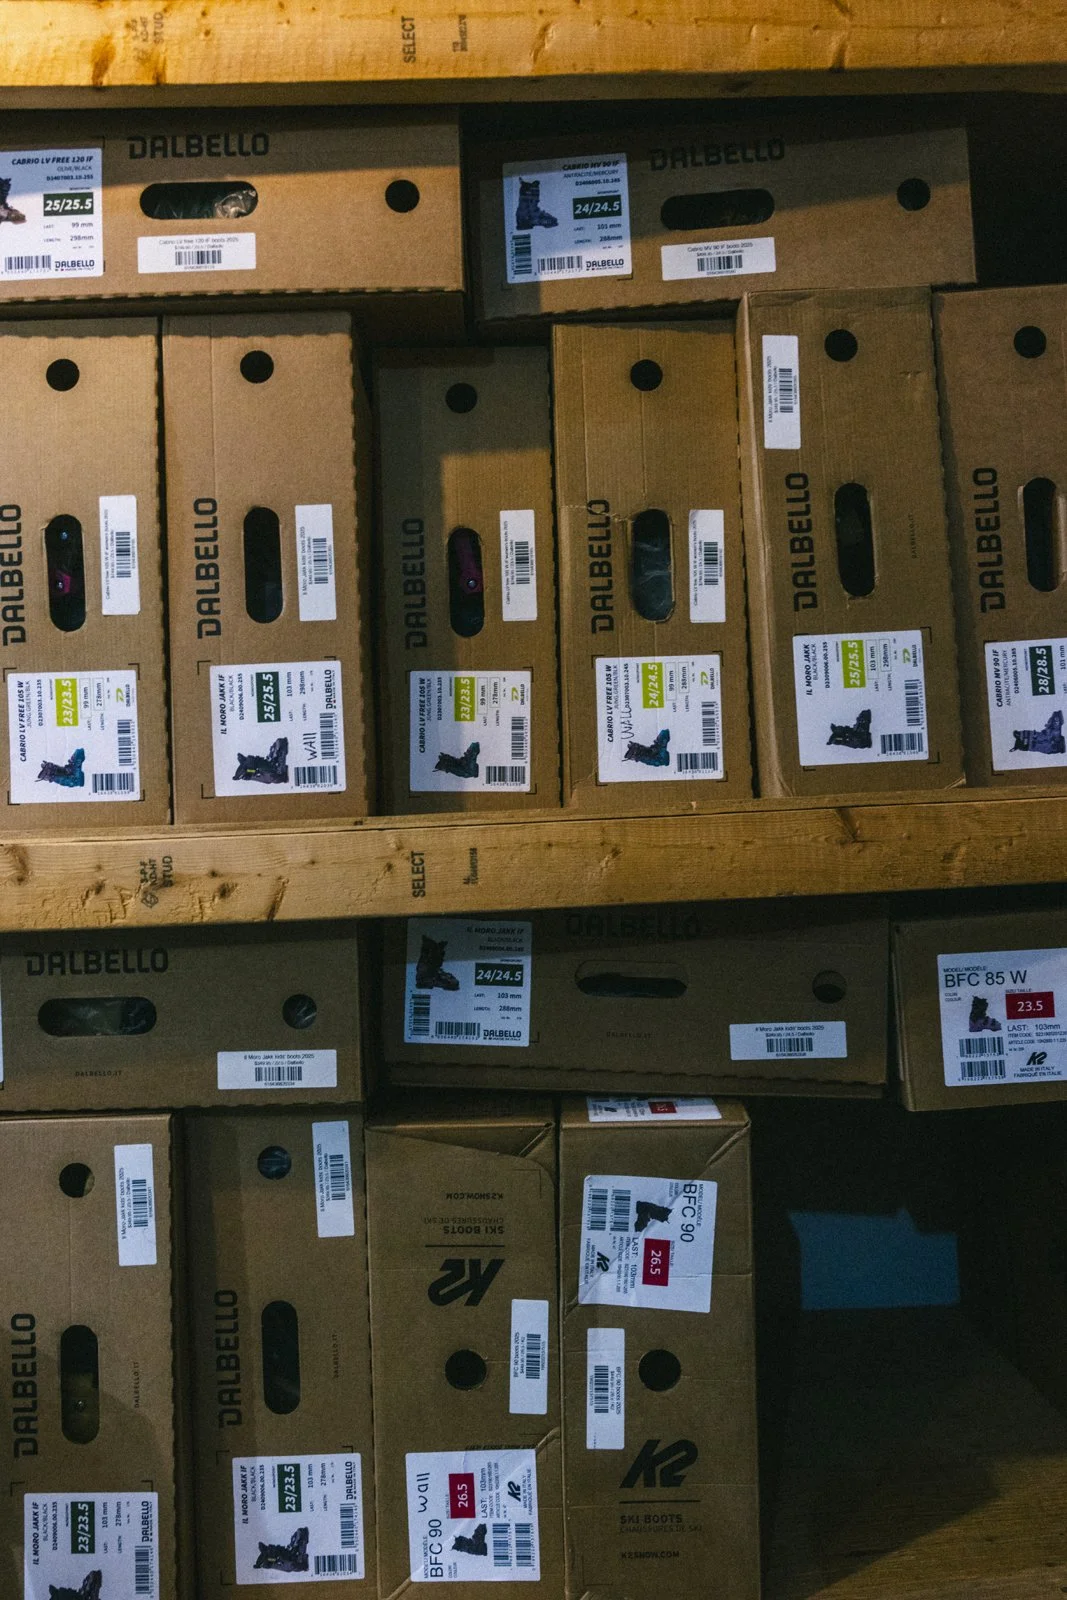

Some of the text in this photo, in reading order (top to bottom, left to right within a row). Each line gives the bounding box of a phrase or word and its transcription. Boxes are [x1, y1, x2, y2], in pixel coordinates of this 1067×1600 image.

[401, 16, 416, 63] SELECT
[127, 132, 270, 159] DALBELLO
[650, 138, 785, 171] DALBELLO
[12, 158, 40, 166] CABRIO
[44, 199, 93, 212] 25/25.5
[574, 201, 620, 215] 24/24.5
[55, 260, 95, 269] DALBELLO
[585, 258, 624, 269] DALBELLO
[785, 473, 818, 613] DALBELLO
[973, 467, 1005, 613] DALBELLO
[0, 504, 25, 646] DALBELLO
[194, 498, 221, 640] DALBELLO
[587, 499, 614, 634] DALBELLO
[402, 518, 428, 651] DALBELLO
[803, 644, 811, 663] JAKK
[847, 641, 861, 686] 25/25.5
[870, 646, 876, 659] mm
[1059, 645, 1065, 658] mm
[219, 674, 225, 682] IF
[286, 672, 292, 685] mm
[669, 670, 674, 682] mm
[992, 649, 1003, 707] CABRIO MV 90 IF
[1003, 650, 1011, 706] ANTRACITE/MERCURY
[1035, 647, 1051, 693] 28/28.5
[17, 681, 23, 689] W
[262, 673, 276, 721] 25/25.5
[324, 670, 334, 709] DALBELLO
[480, 685, 486, 706] 99 mm
[648, 664, 661, 707] 24/24.5
[61, 680, 75, 725] 23/23.5
[83, 687, 90, 709] 99 mm
[460, 678, 472, 720] 23/23.5
[606, 705, 613, 715] LV
[19, 724, 25, 733] LV
[419, 717, 425, 726] LV
[411, 850, 426, 898] SELECT
[564, 912, 701, 939] DALBELLO
[24, 949, 169, 976] DALBELLO
[476, 969, 522, 983] 24/24.5
[945, 970, 1028, 988] BFC 85 W
[1017, 1001, 1043, 1012] 23.5
[483, 1029, 521, 1038] DALBELLO
[1026, 1052, 1048, 1065] K2
[680, 1183, 697, 1243] BFC 90
[443, 1226, 504, 1234] SKI BOOTS
[631, 1237, 639, 1258] LAST:
[597, 1252, 610, 1271] K2
[650, 1249, 662, 1275] 26.5
[427, 1259, 505, 1306] K2
[214, 1289, 242, 1429] DALBELLO
[11, 1314, 38, 1458] DALBELLO
[240, 1465, 246, 1473] IF
[307, 1464, 313, 1477] mm
[619, 1440, 698, 1488] K2
[284, 1465, 298, 1511] 23/23.5
[345, 1462, 354, 1501] DALBELLO
[416, 1472, 430, 1513] wall
[508, 1481, 521, 1502] K2
[33, 1501, 39, 1510] IF
[457, 1483, 469, 1508] 26.5
[102, 1502, 108, 1515] mm
[620, 1514, 683, 1524] SKI BOOTS
[77, 1503, 91, 1553] 23/23.5
[141, 1501, 150, 1542] DALBELLO
[33, 1556, 39, 1565] IL
[428, 1519, 443, 1578] BFC 90
[621, 1551, 680, 1559] K2SNOW.COM
